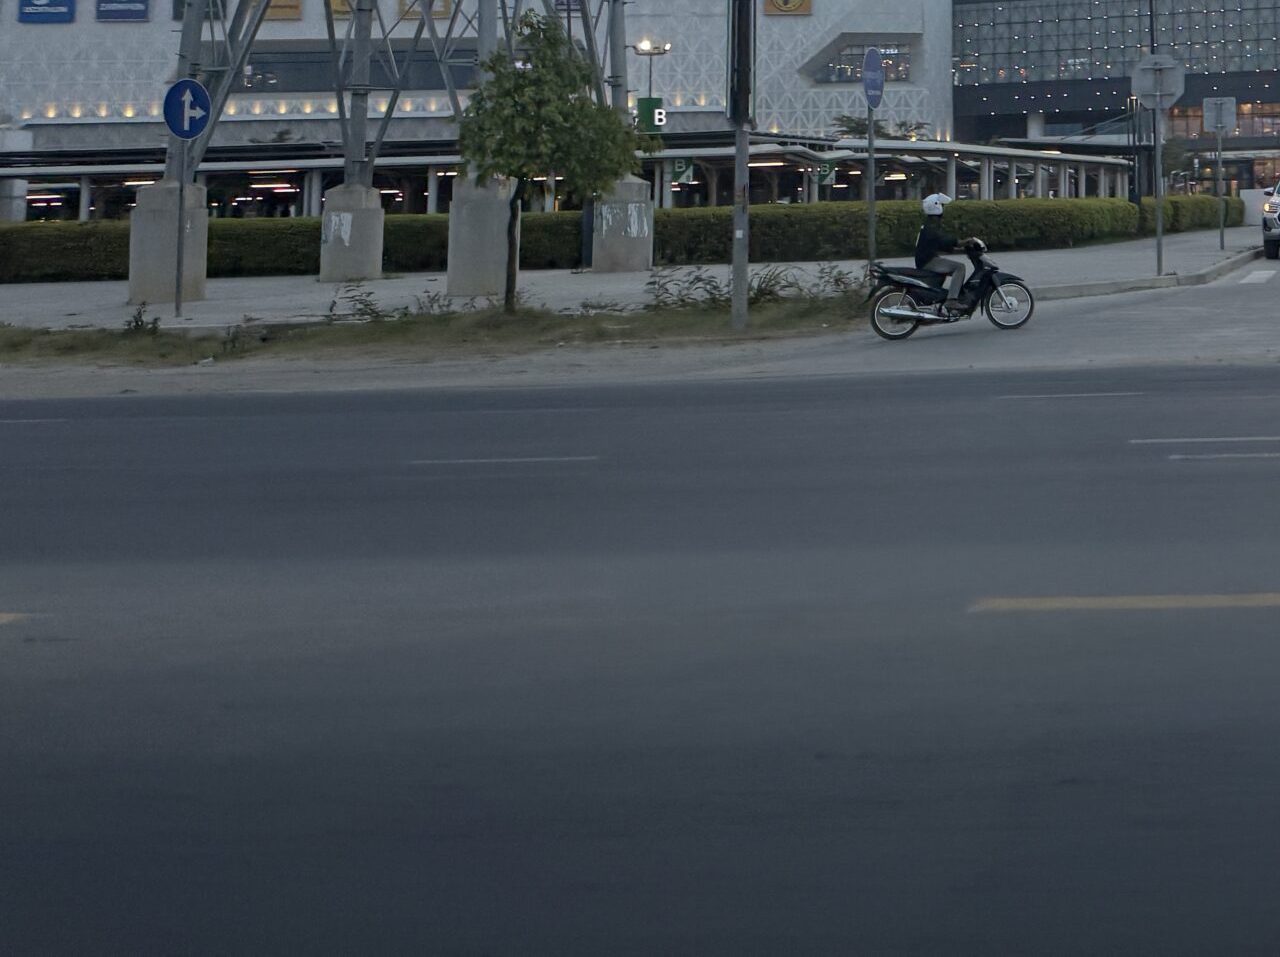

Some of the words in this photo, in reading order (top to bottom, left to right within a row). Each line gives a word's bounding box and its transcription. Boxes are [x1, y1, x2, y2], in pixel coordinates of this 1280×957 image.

[654, 108, 667, 126] B
[675, 159, 686, 172] B
[820, 163, 831, 175] B
